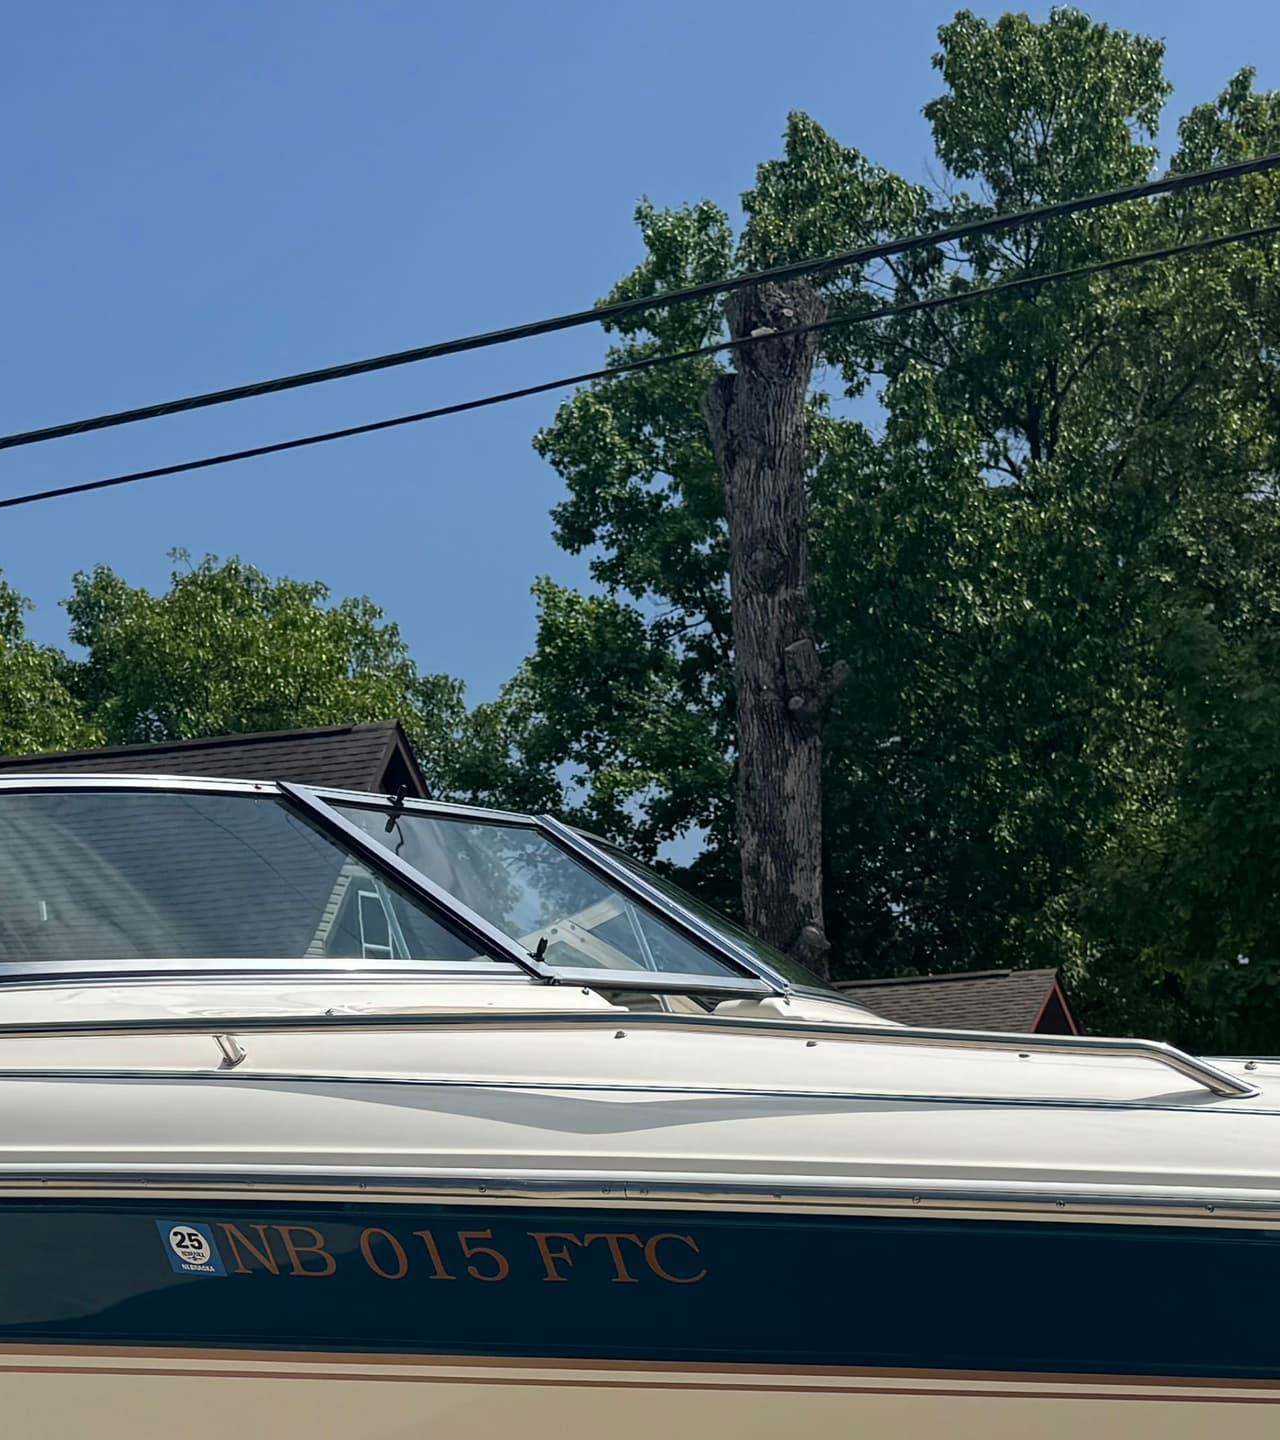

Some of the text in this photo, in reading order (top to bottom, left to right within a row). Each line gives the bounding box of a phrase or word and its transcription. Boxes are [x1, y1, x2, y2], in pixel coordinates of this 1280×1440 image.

[173, 1231, 203, 1250] 25
[216, 1222, 708, 1283] NB 015 FTC
